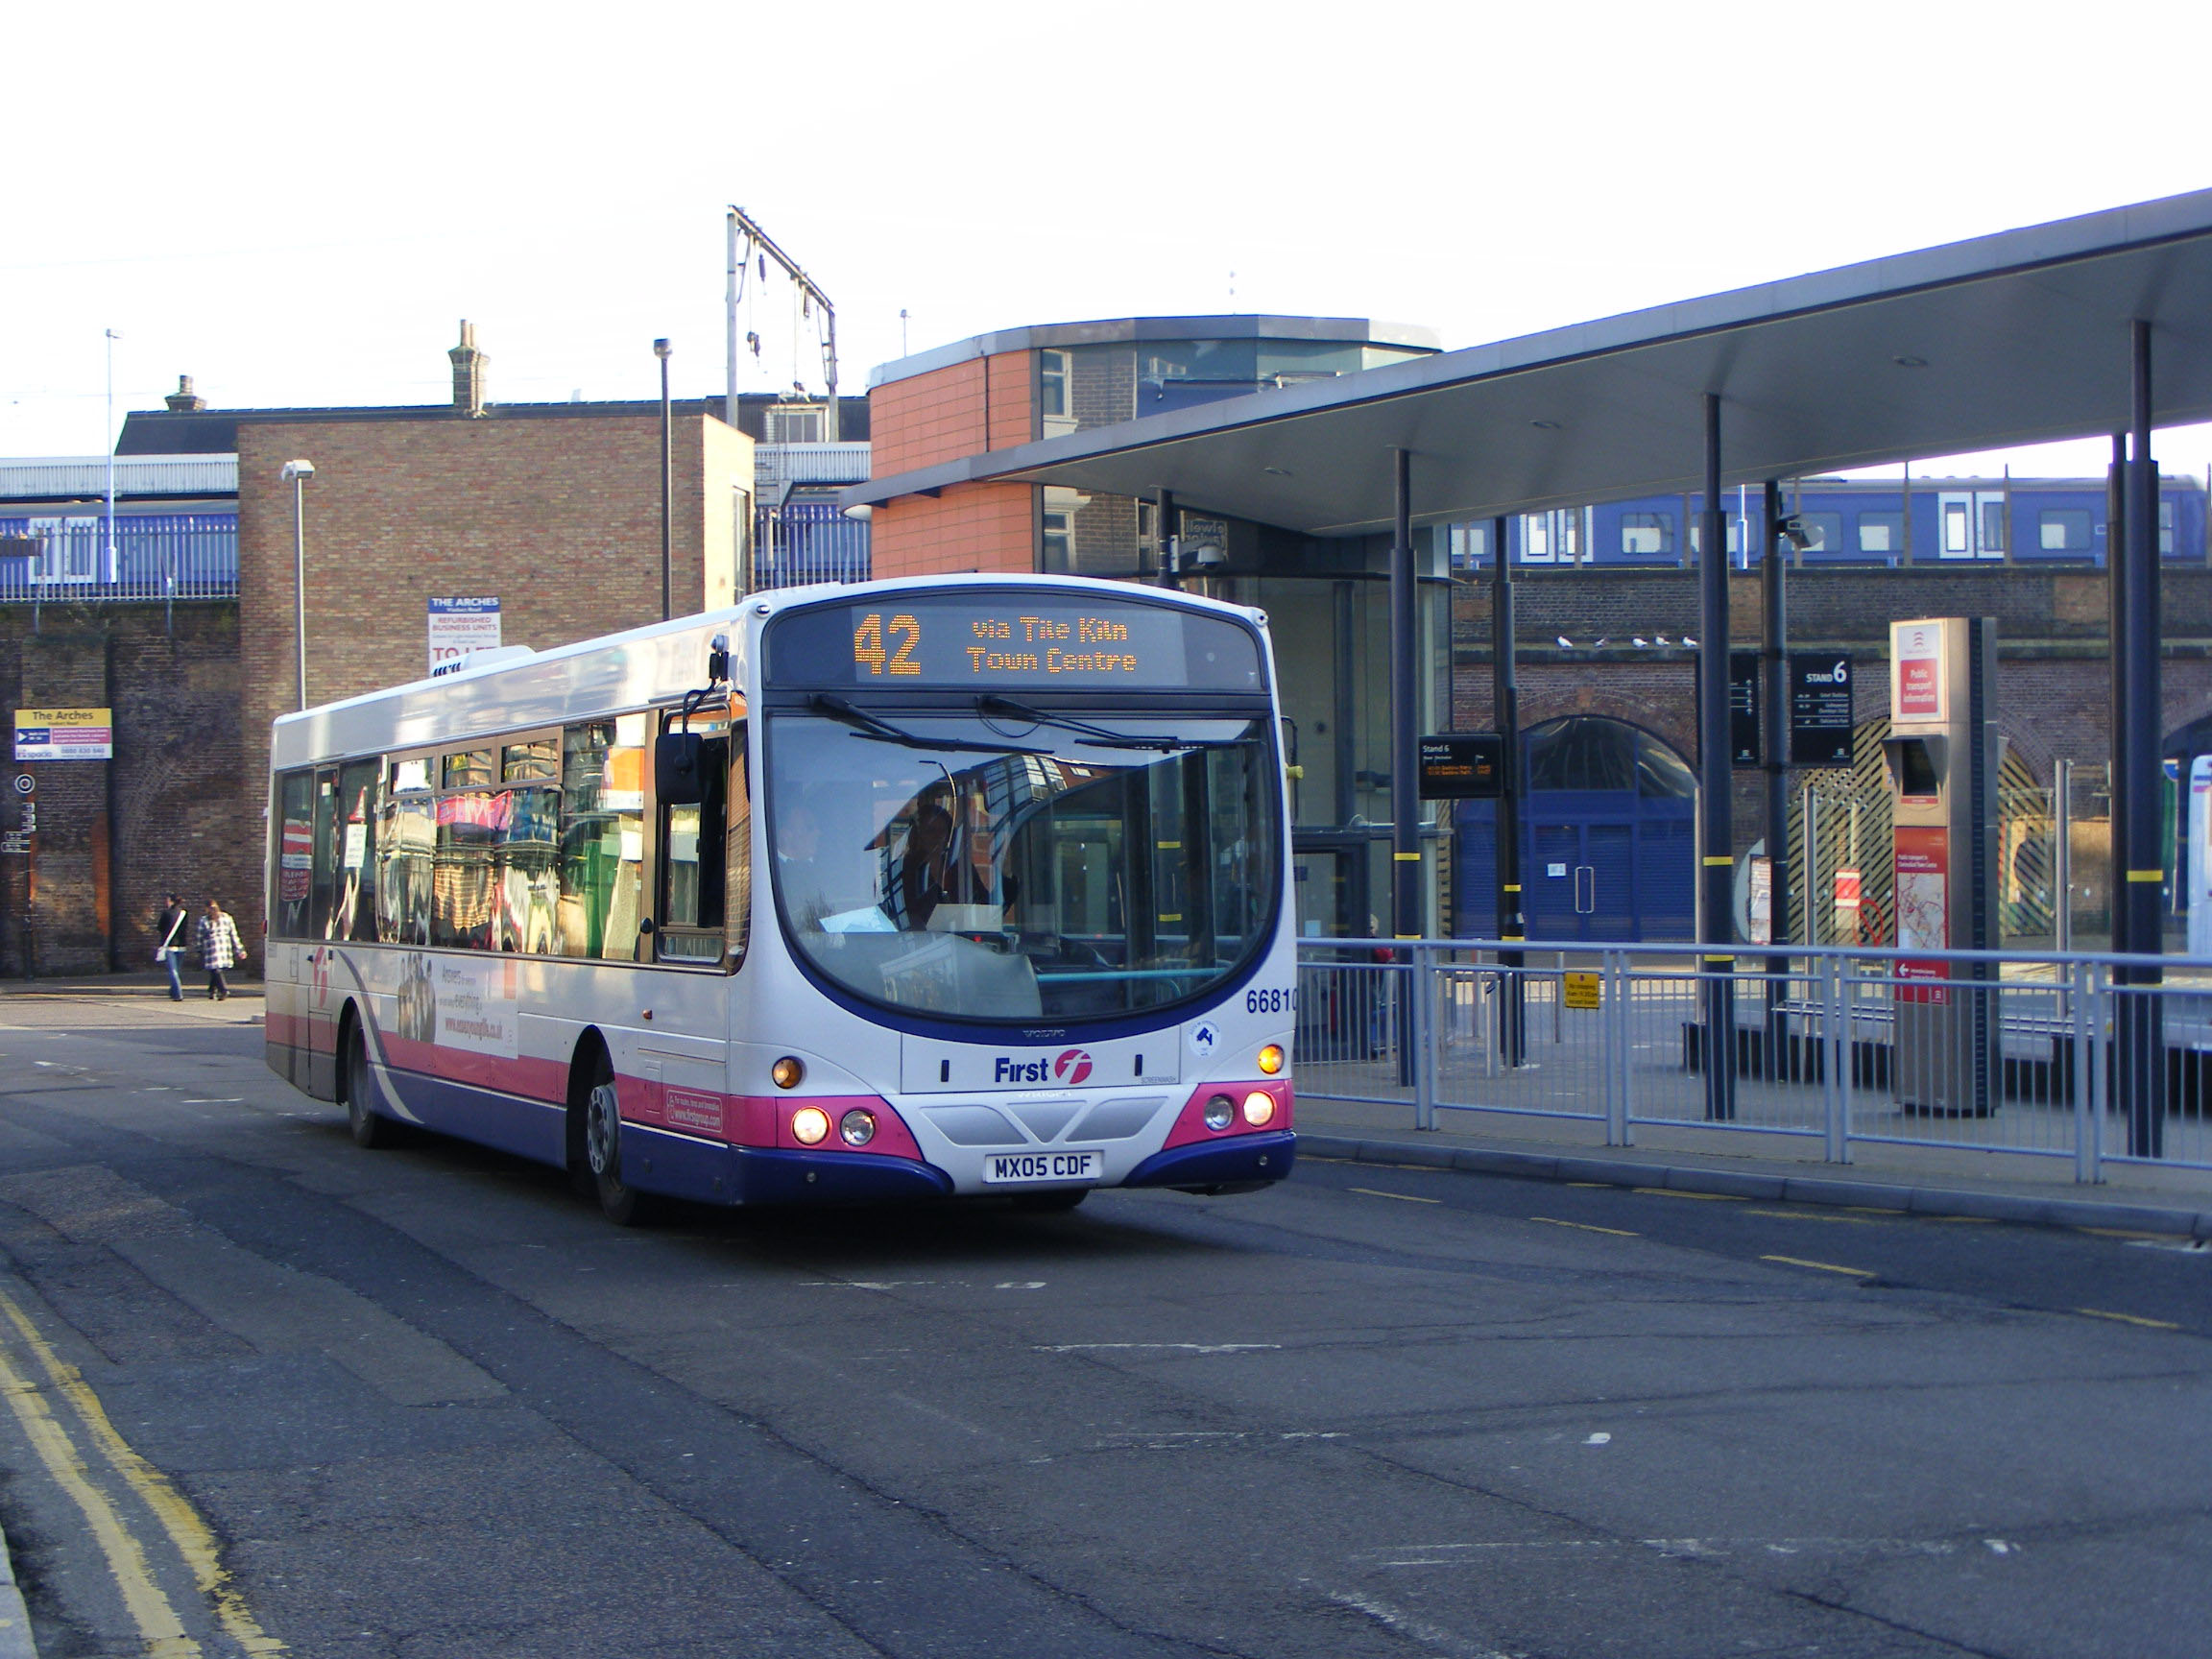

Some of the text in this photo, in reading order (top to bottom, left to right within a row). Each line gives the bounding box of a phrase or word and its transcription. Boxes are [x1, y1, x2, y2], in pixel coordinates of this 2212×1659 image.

[431, 596, 499, 607] THE ARCHES
[972, 615, 1129, 643] via Tile Kiln
[854, 613, 922, 675] 42
[966, 645, 1138, 674] Town Centre
[1806, 661, 1847, 683] STAND 6
[1910, 668, 1929, 679] Public
[33, 710, 94, 720] The Arches
[1423, 744, 1451, 753] Stand 6
[1022, 1028, 1066, 1038] VOLVO
[995, 1056, 1048, 1083] First
[995, 1155, 1092, 1179] MX05 CDF
